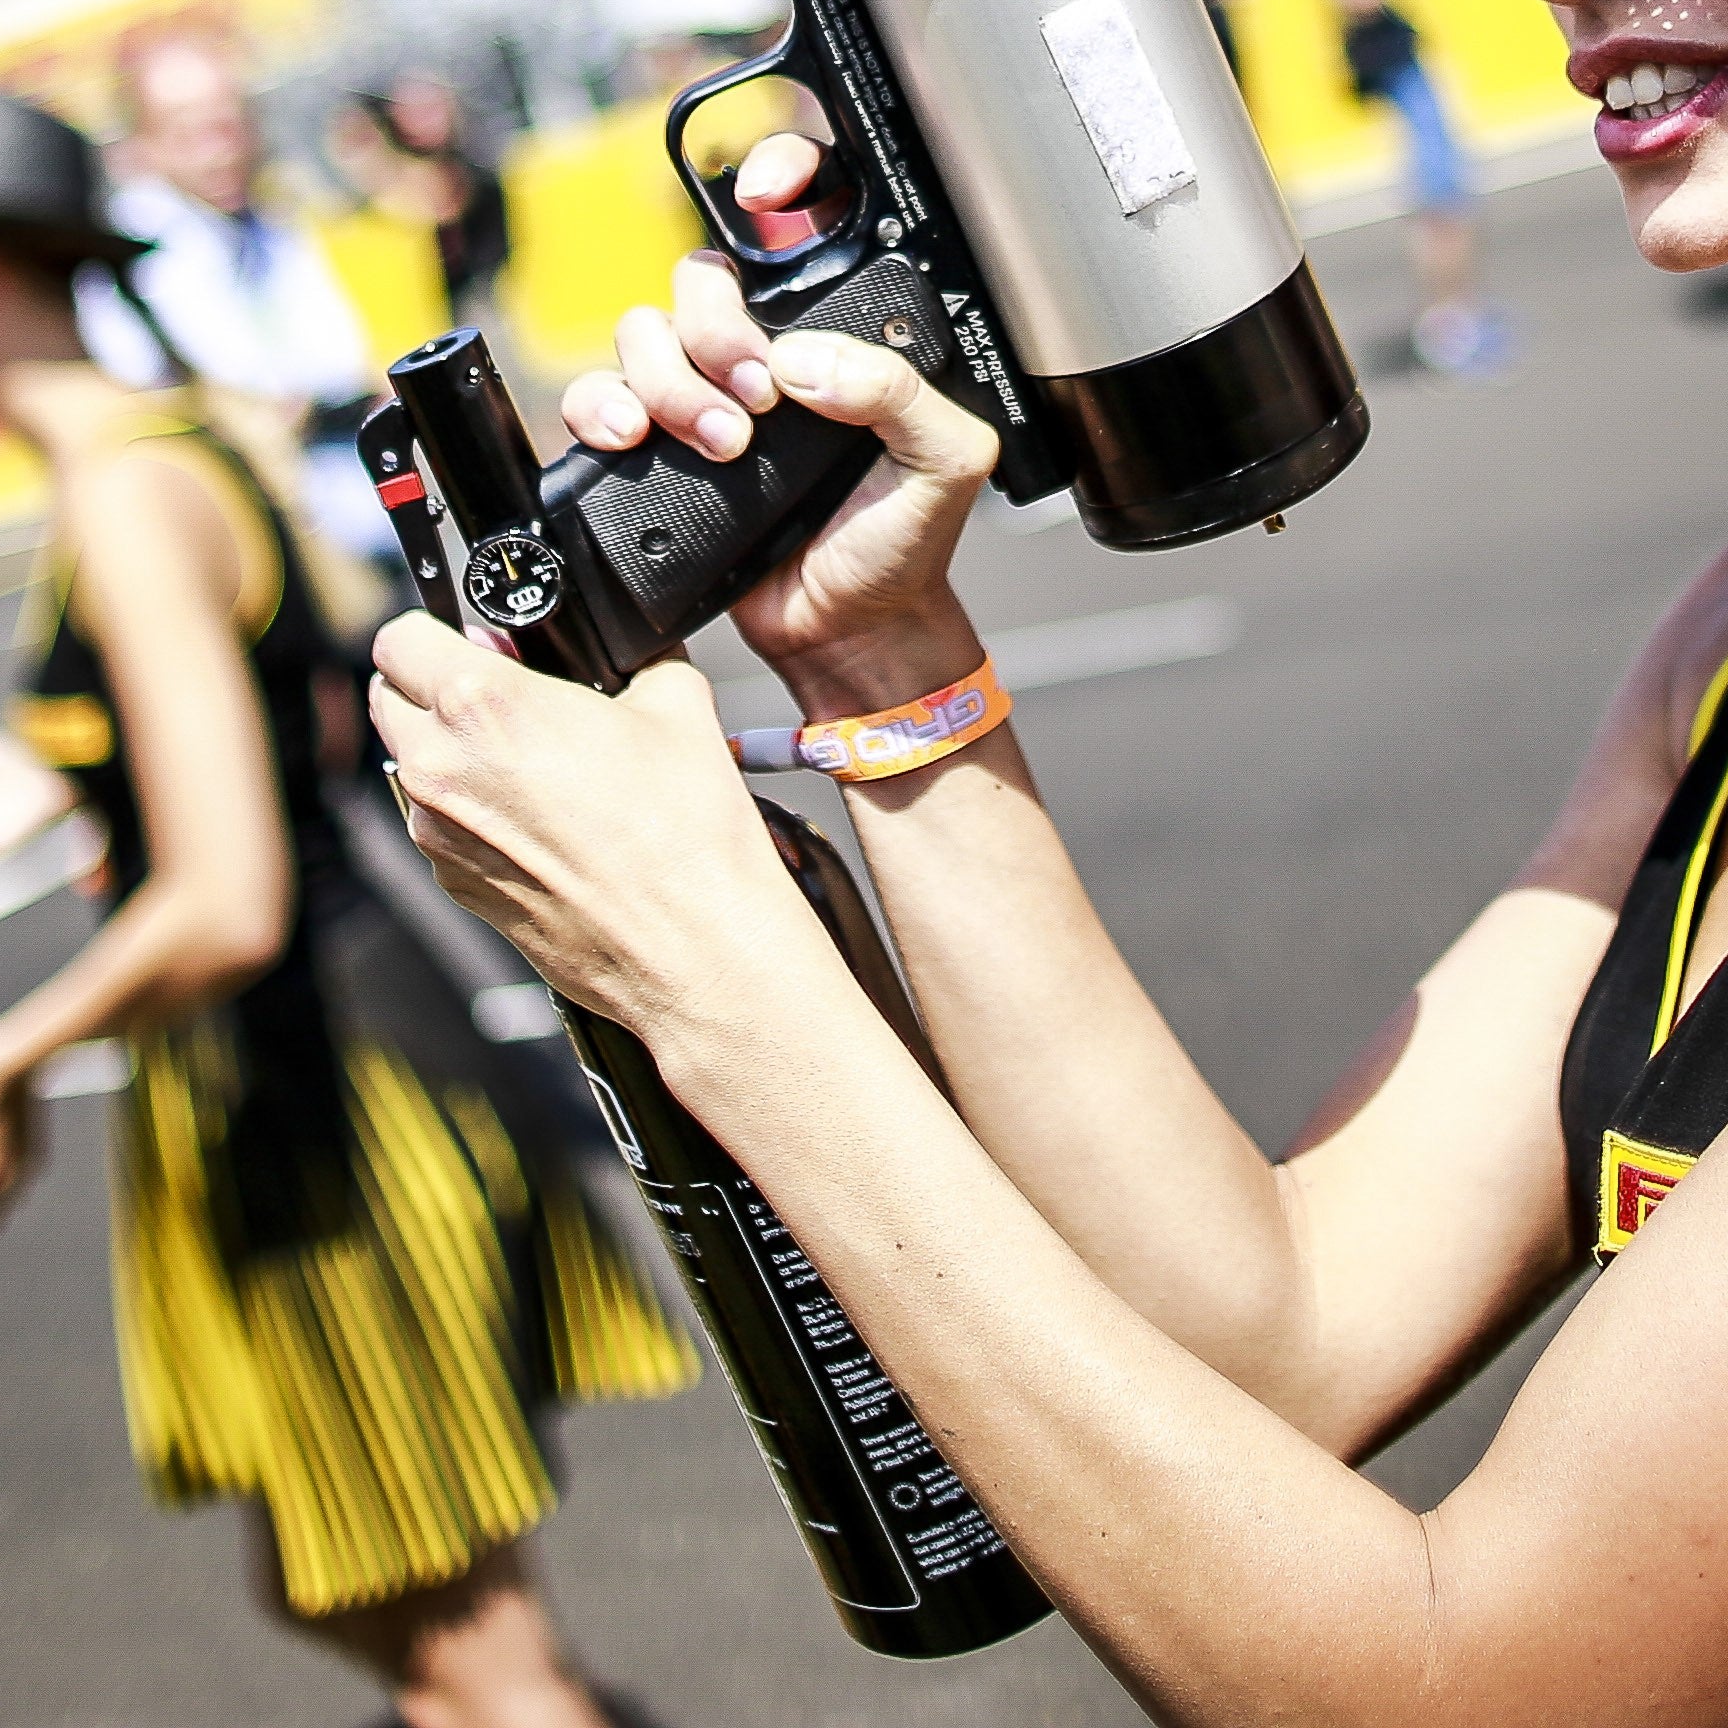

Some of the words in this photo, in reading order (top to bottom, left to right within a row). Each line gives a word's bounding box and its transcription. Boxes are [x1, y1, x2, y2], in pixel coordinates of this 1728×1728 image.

[834, 17, 850, 44] cause
[847, 48, 865, 82] serious
[858, 38, 868, 49] IS
[863, 51, 879, 72] NOT
[874, 75, 883, 85] A
[880, 86, 893, 106] TOY
[841, 71, 858, 98] Read
[854, 99, 876, 138] owner's
[871, 139, 894, 175] manual
[887, 176, 906, 209] before
[875, 114, 884, 124] or
[902, 178, 915, 195] not
[908, 195, 927, 220] point
[954, 326, 978, 355] 250
[968, 359, 990, 382] PSI
[965, 308, 994, 349] MAX
[982, 350, 1026, 426] PRESSURE
[855, 690, 986, 762] GRID
